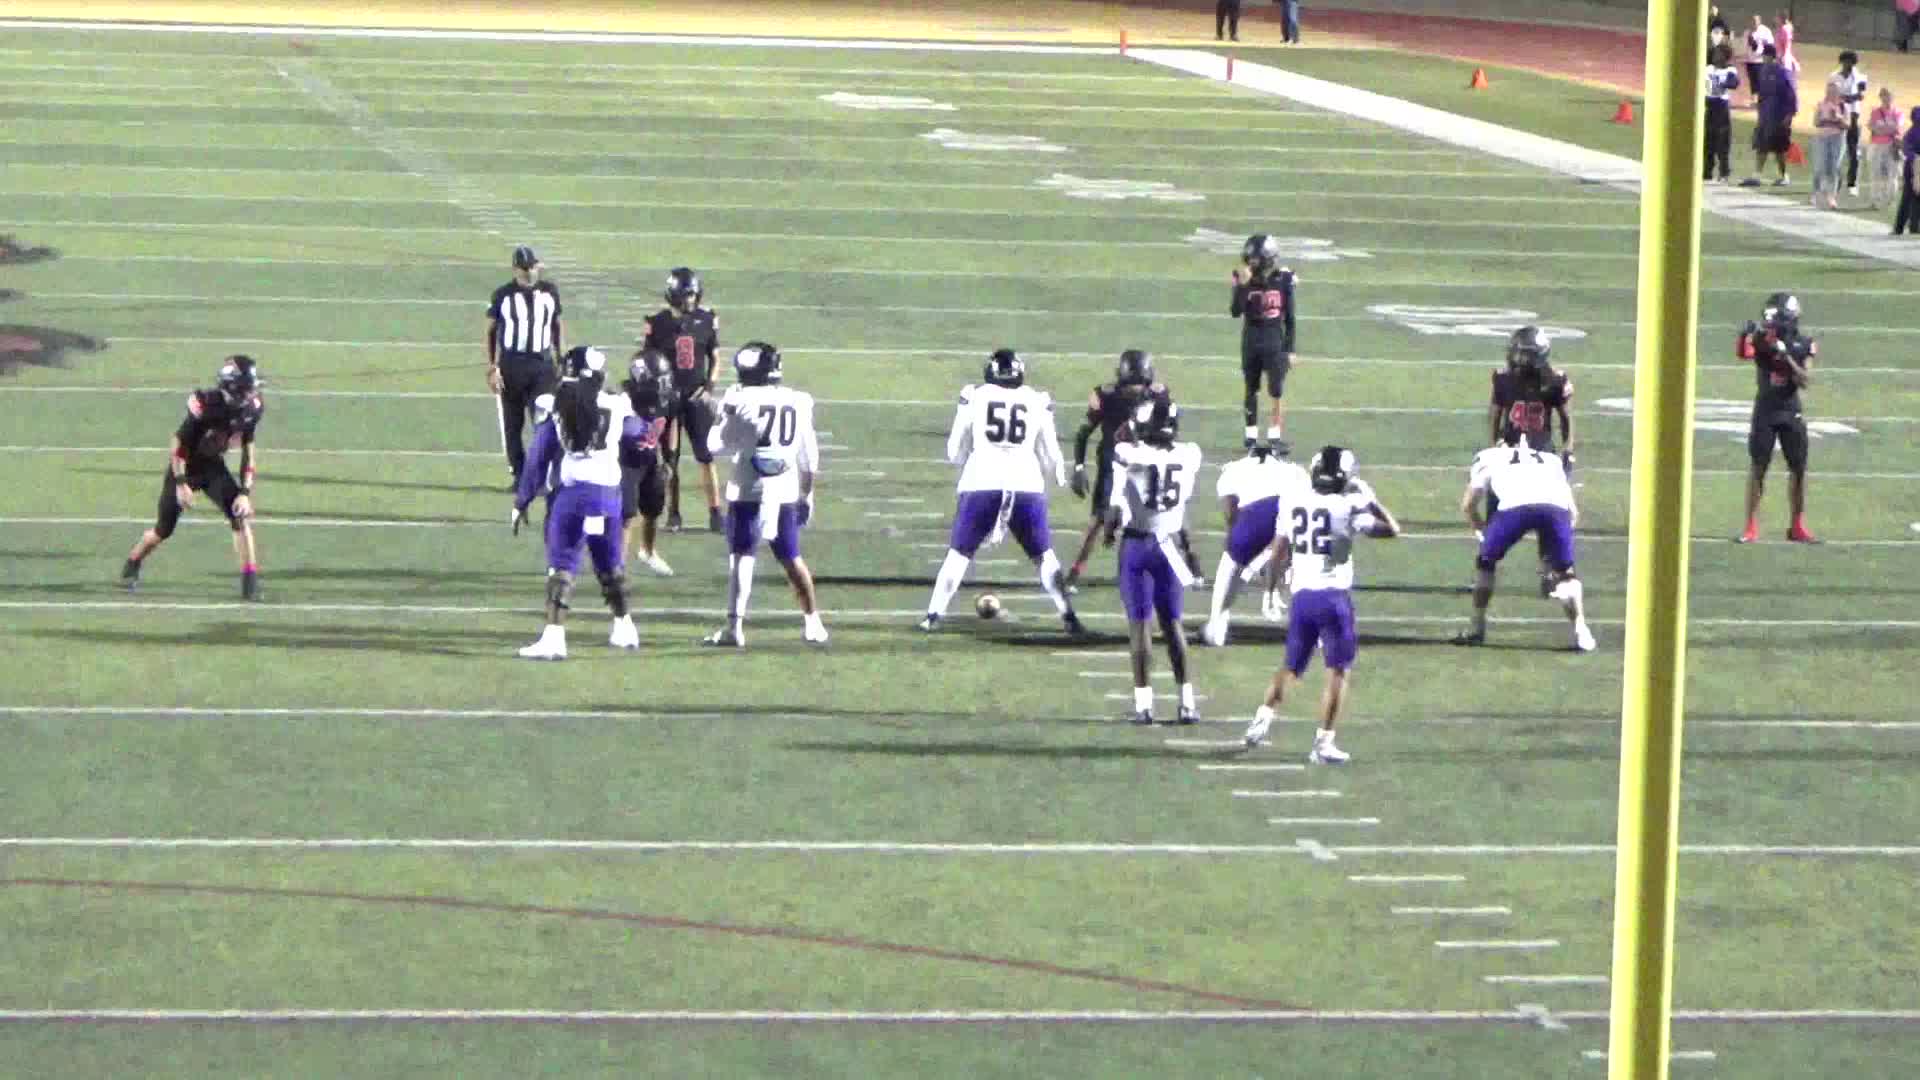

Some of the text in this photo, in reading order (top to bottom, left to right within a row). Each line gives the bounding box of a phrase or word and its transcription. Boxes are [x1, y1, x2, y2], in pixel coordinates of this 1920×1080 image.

[756, 404, 796, 446] 70
[985, 400, 1028, 444] 56
[1292, 506, 1331, 554] 22
